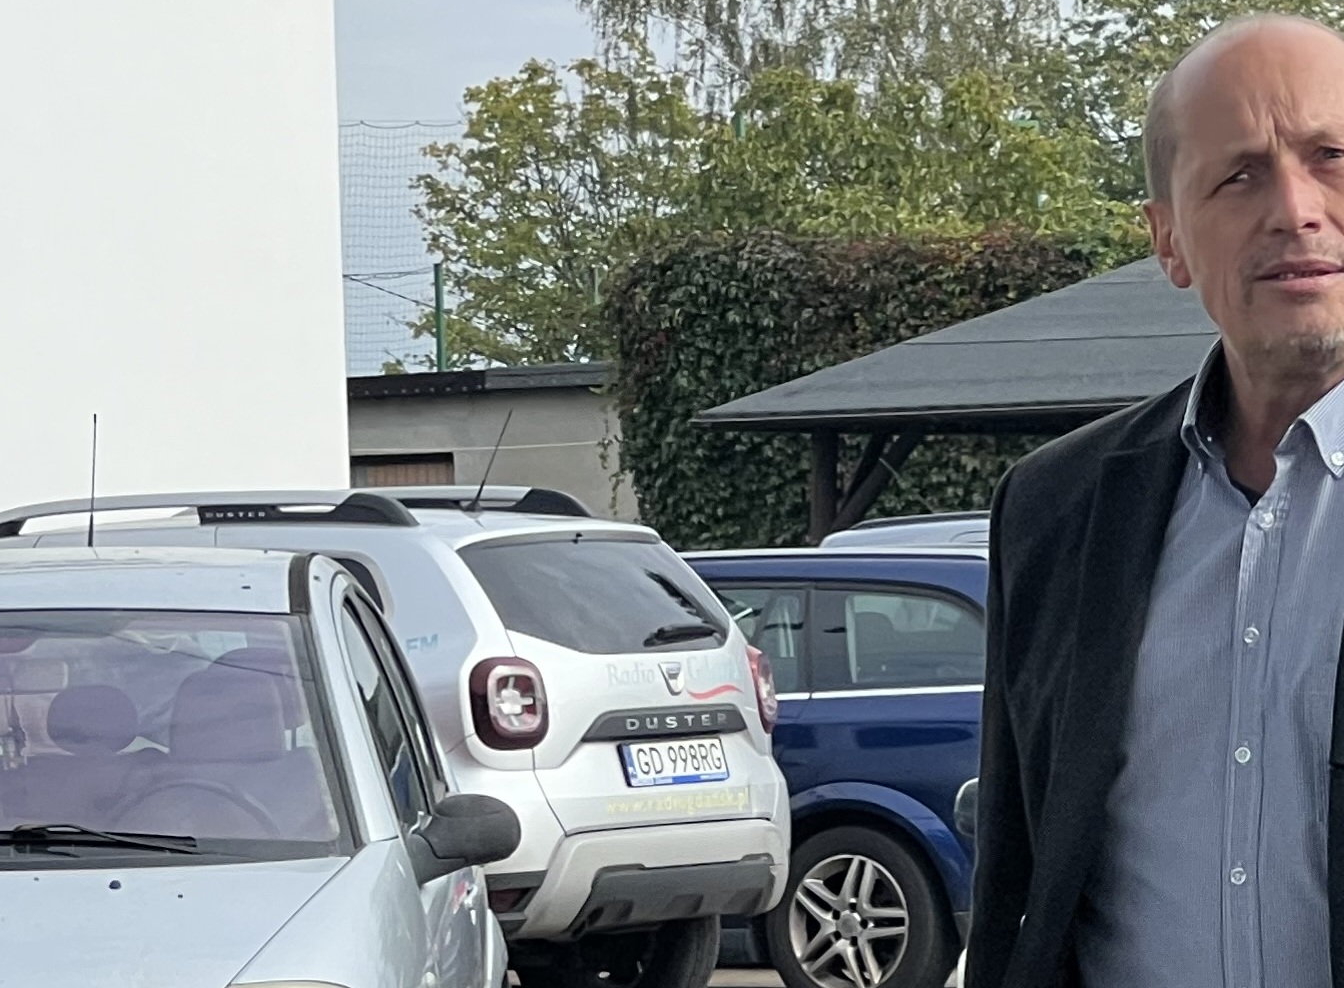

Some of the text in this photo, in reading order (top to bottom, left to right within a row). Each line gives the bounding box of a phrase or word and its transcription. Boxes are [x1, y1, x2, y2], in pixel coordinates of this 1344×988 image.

[607, 661, 656, 686] Radio
[626, 713, 728, 730] DUSTER
[636, 743, 723, 775] GD 998RG
